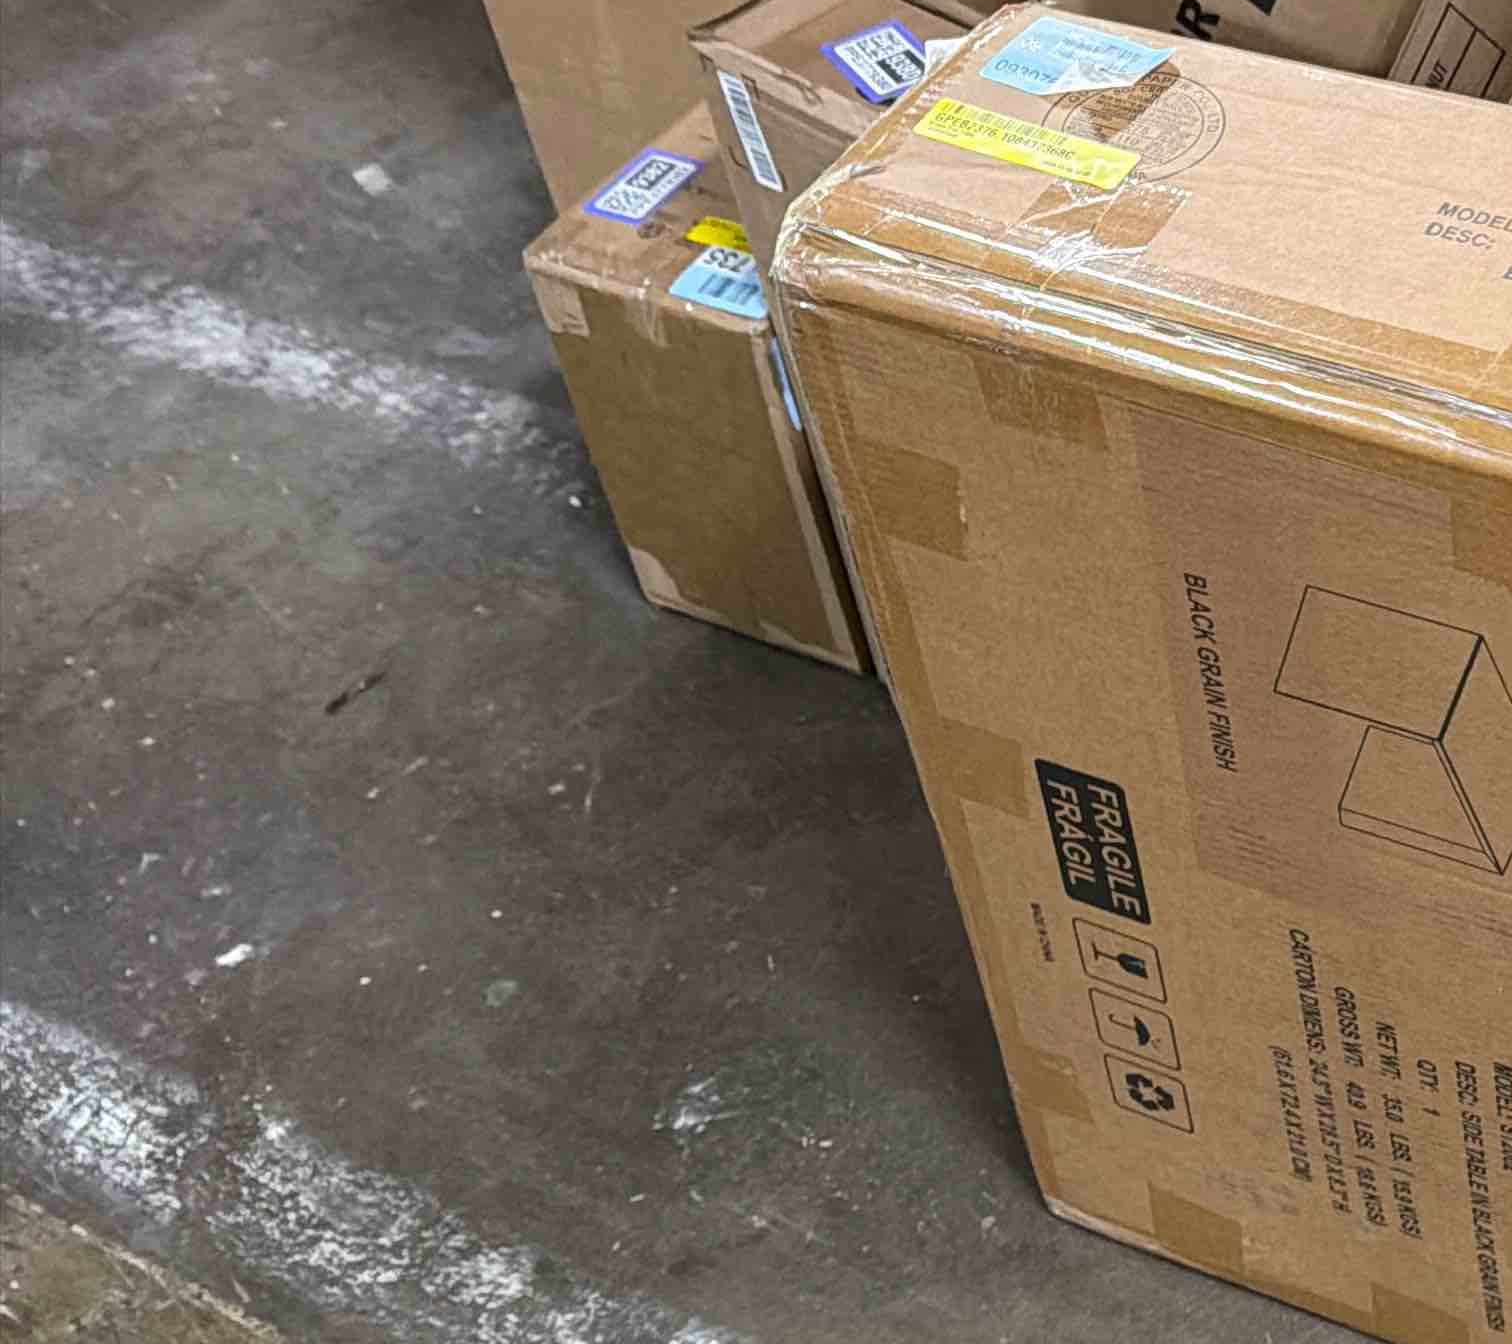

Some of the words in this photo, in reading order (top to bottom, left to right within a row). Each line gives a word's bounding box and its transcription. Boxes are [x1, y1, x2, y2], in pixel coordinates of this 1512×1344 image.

[1425, 222, 1496, 250] DESC:
[1184, 572, 1211, 642] BLACK
[1198, 646, 1223, 705] GRAIN
[1211, 710, 1237, 773] FINISH
[1089, 784, 1142, 919] FRAGILE
[1288, 929, 1317, 991] CARTON
[1333, 987, 1360, 1041] GROSS
[1374, 1022, 1398, 1052] NET
[1415, 1059, 1439, 1092] QTY:
[1453, 1061, 1480, 1104] DESC:
[1421, 1106, 1440, 1116] 1
[1460, 1110, 1484, 1146] SIDE
[1465, 1147, 1489, 1190] TABLE
[1470, 1191, 1490, 1205] IN
[1472, 1207, 1496, 1253] BLACK
[1477, 1253, 1501, 1293] GRAIN
